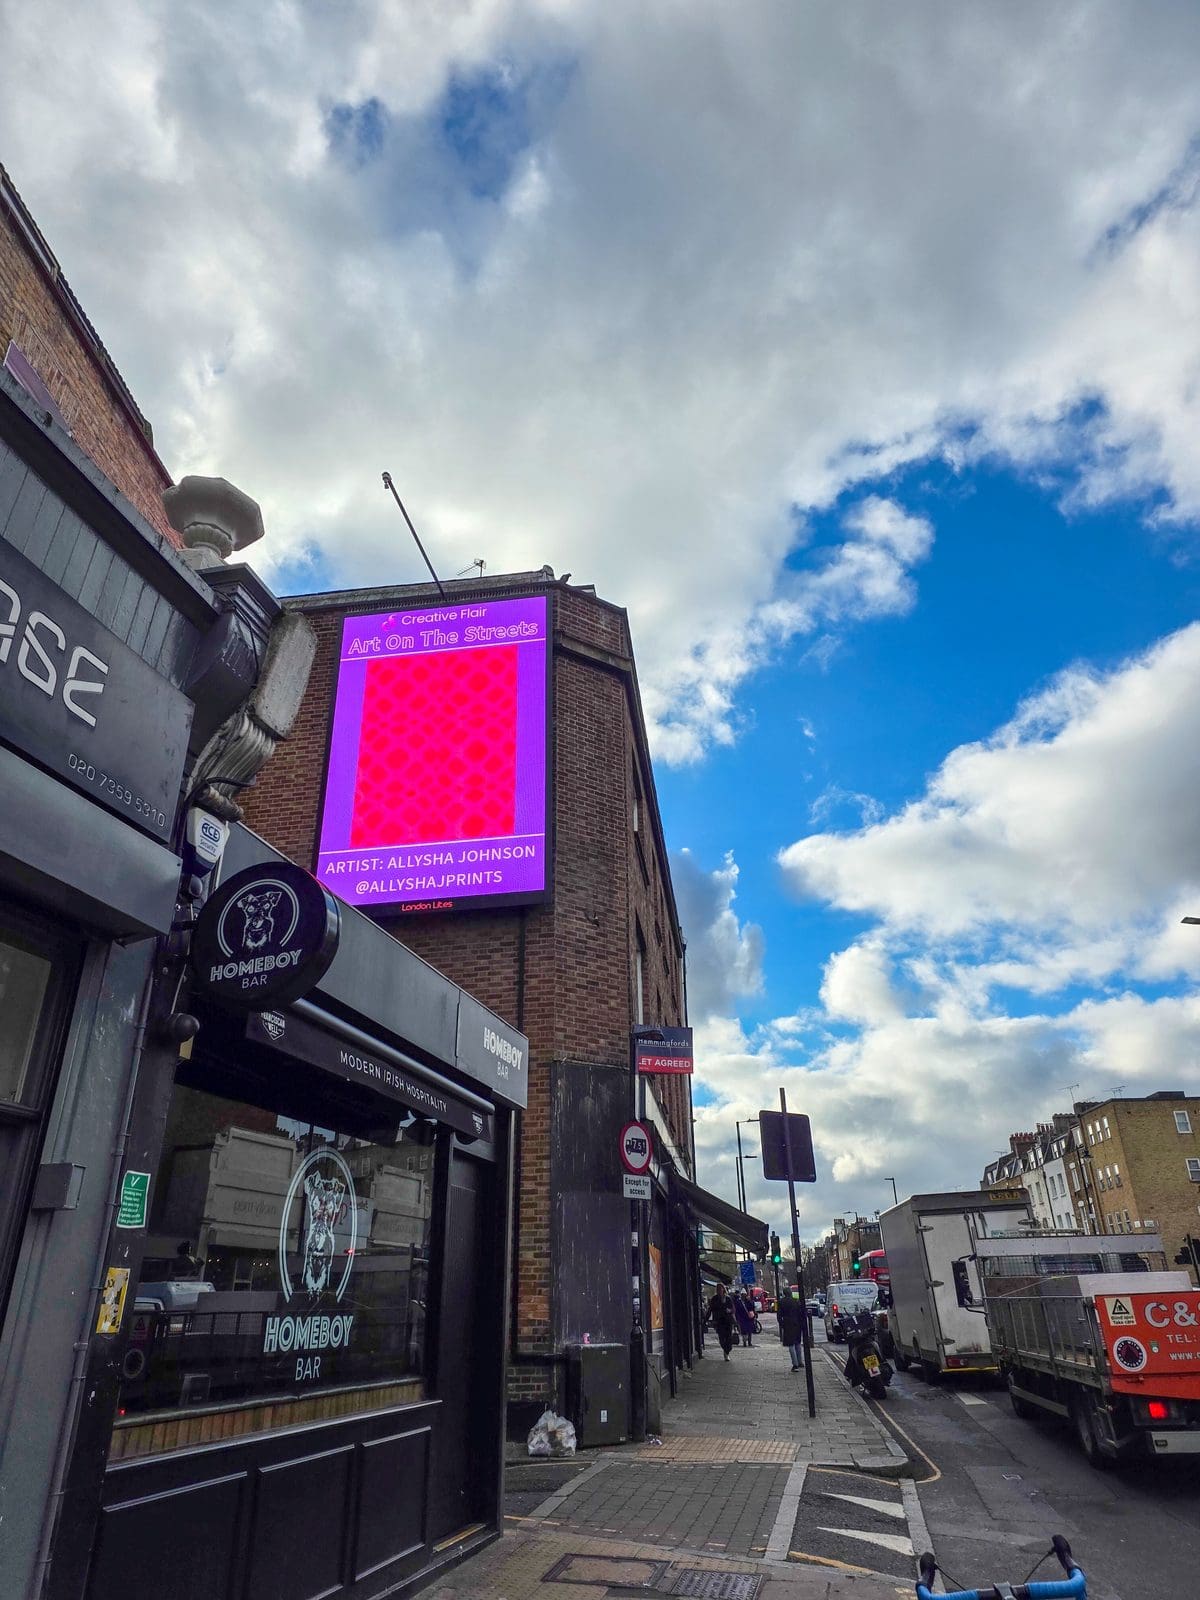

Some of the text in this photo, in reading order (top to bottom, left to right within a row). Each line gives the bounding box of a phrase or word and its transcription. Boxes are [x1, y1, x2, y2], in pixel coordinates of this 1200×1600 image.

[401, 607, 487, 625] Creative Flair
[348, 621, 539, 654] Art On The Streets
[68, 753, 166, 827] 020 7359 5310
[325, 845, 536, 874] ARTIST: ALLYSHA JOHNSON
[355, 870, 503, 895] @ALLYSHAJPRINTS
[401, 902, 431, 912] London
[210, 949, 302, 982] HOMEBOY
[241, 974, 268, 989] BAR
[483, 1027, 523, 1071] HOMEBOY
[496, 1063, 509, 1081] BAR
[638, 1057, 652, 1066] ET
[654, 1059, 691, 1068] AGREED
[340, 1050, 447, 1112] MODERN IRISH HOSPITALITY
[624, 1177, 641, 1187] Except
[629, 1188, 645, 1196] access
[1144, 1301, 1200, 1328] C&
[263, 1315, 354, 1353] HOMEBOY
[1166, 1334, 1197, 1343] TEL:
[295, 1356, 320, 1381] BAR
